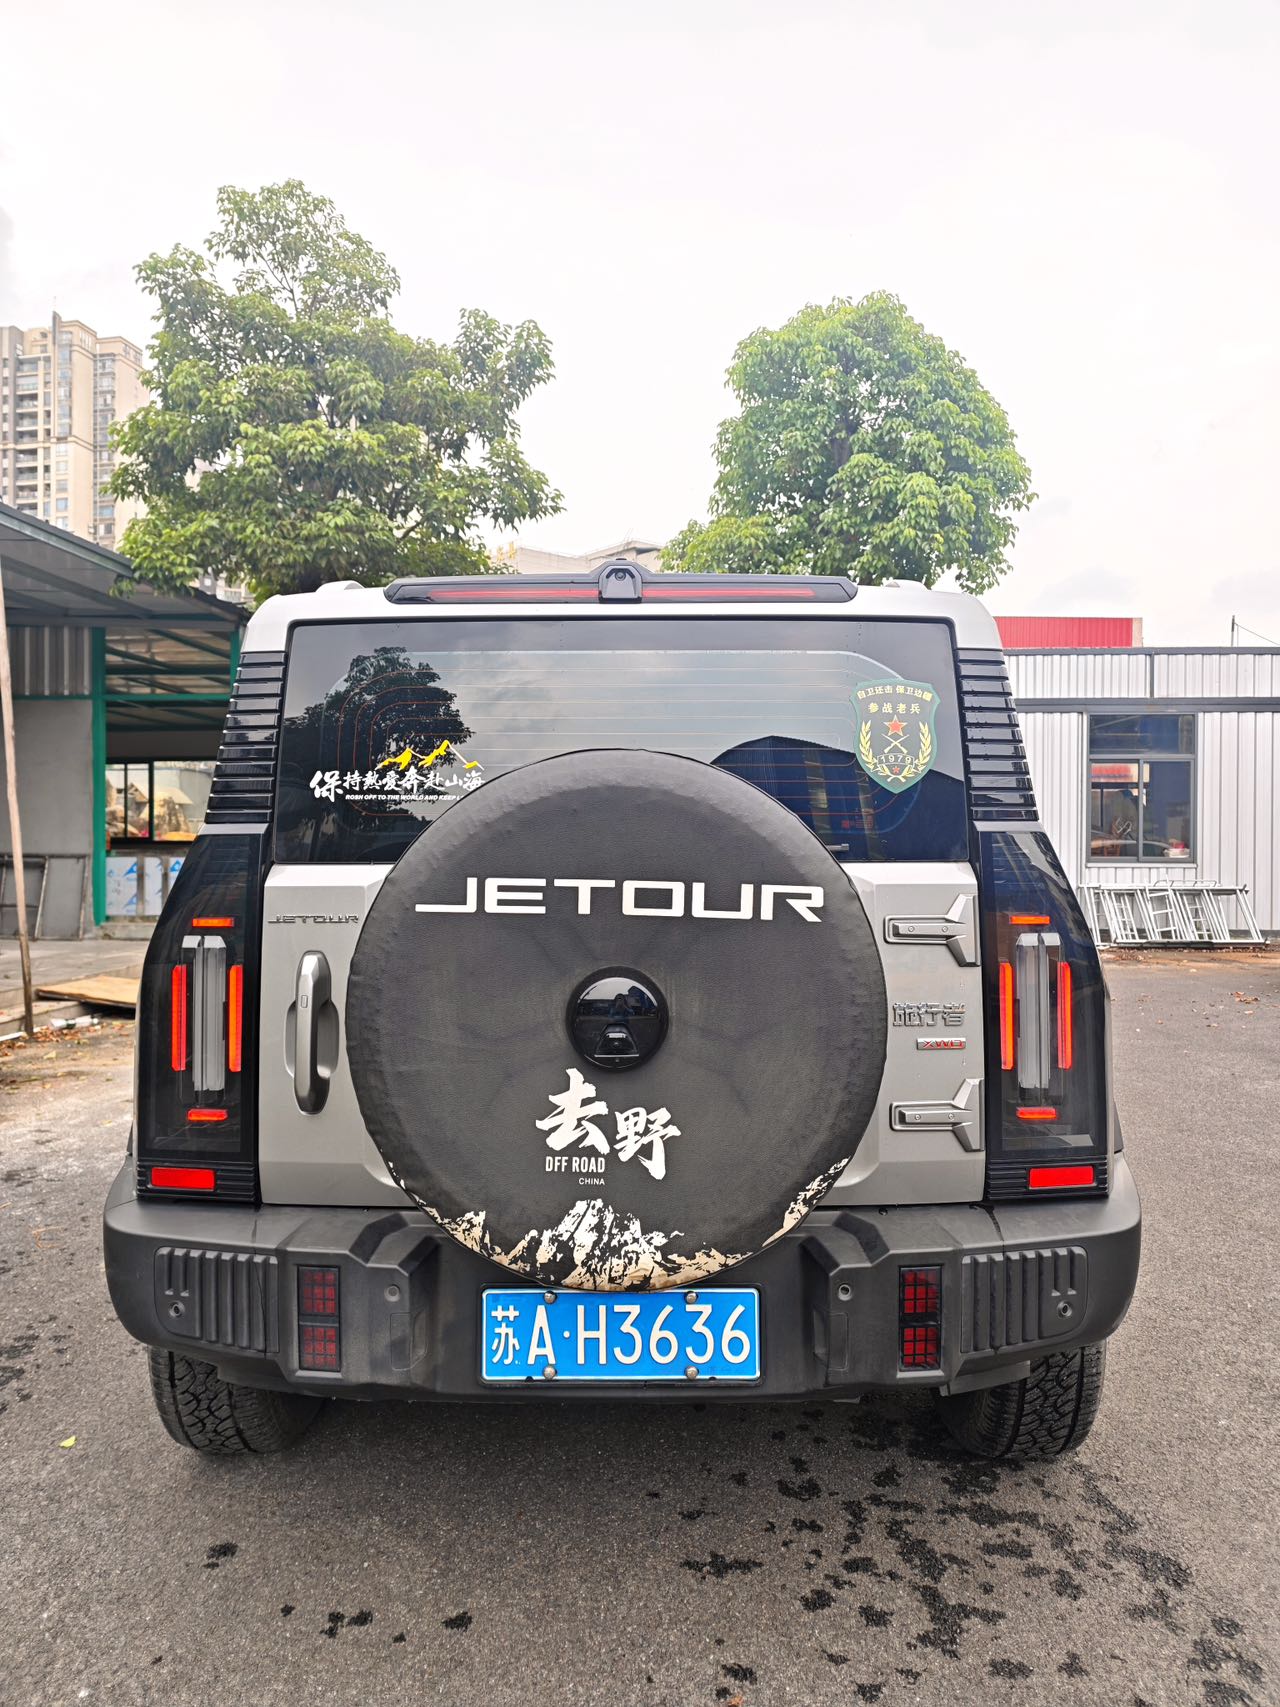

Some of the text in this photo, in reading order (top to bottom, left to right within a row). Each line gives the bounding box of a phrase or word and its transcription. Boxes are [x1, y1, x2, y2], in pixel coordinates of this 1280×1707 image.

[868, 702, 920, 714] 参战老兵
[881, 754, 912, 765] 1979
[414, 877, 825, 923] JETOUR
[267, 914, 358, 924] JETOUR
[922, 1039, 964, 1049] XWD
[535, 1068, 682, 1180] 去野
[572, 1156, 606, 1173] ROAD
[578, 1177, 605, 1186] CHINA
